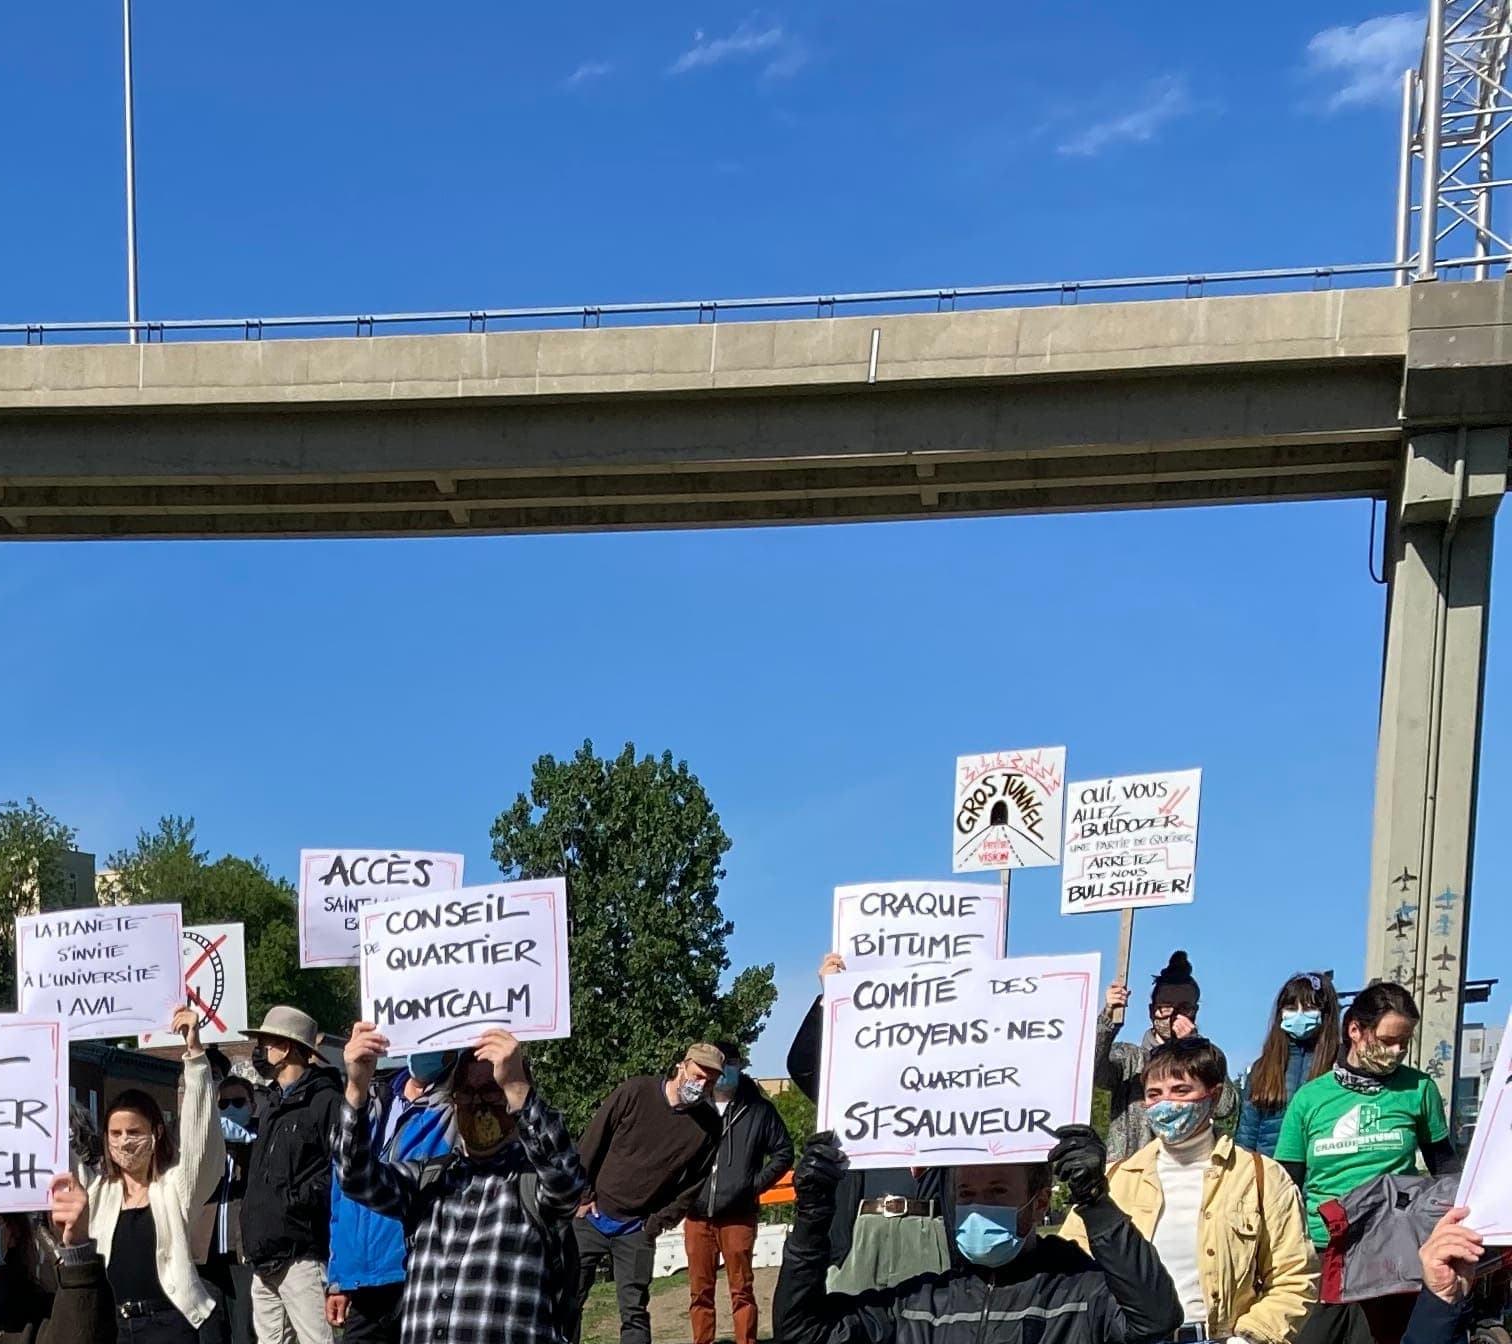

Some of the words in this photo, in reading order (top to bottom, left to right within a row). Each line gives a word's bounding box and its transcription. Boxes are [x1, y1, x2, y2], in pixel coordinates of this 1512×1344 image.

[1122, 781, 1168, 799] VOUS
[956, 775, 998, 834] GROS
[1001, 773, 1044, 841] TUNNEL
[319, 853, 433, 888] ACCÈS
[1111, 867, 1148, 878] NOUS
[860, 892, 981, 918] CRAQUE
[35, 922, 51, 939] LA
[364, 942, 380, 957] DE
[989, 976, 1038, 995] DES
[373, 984, 531, 1026] MONTCALM
